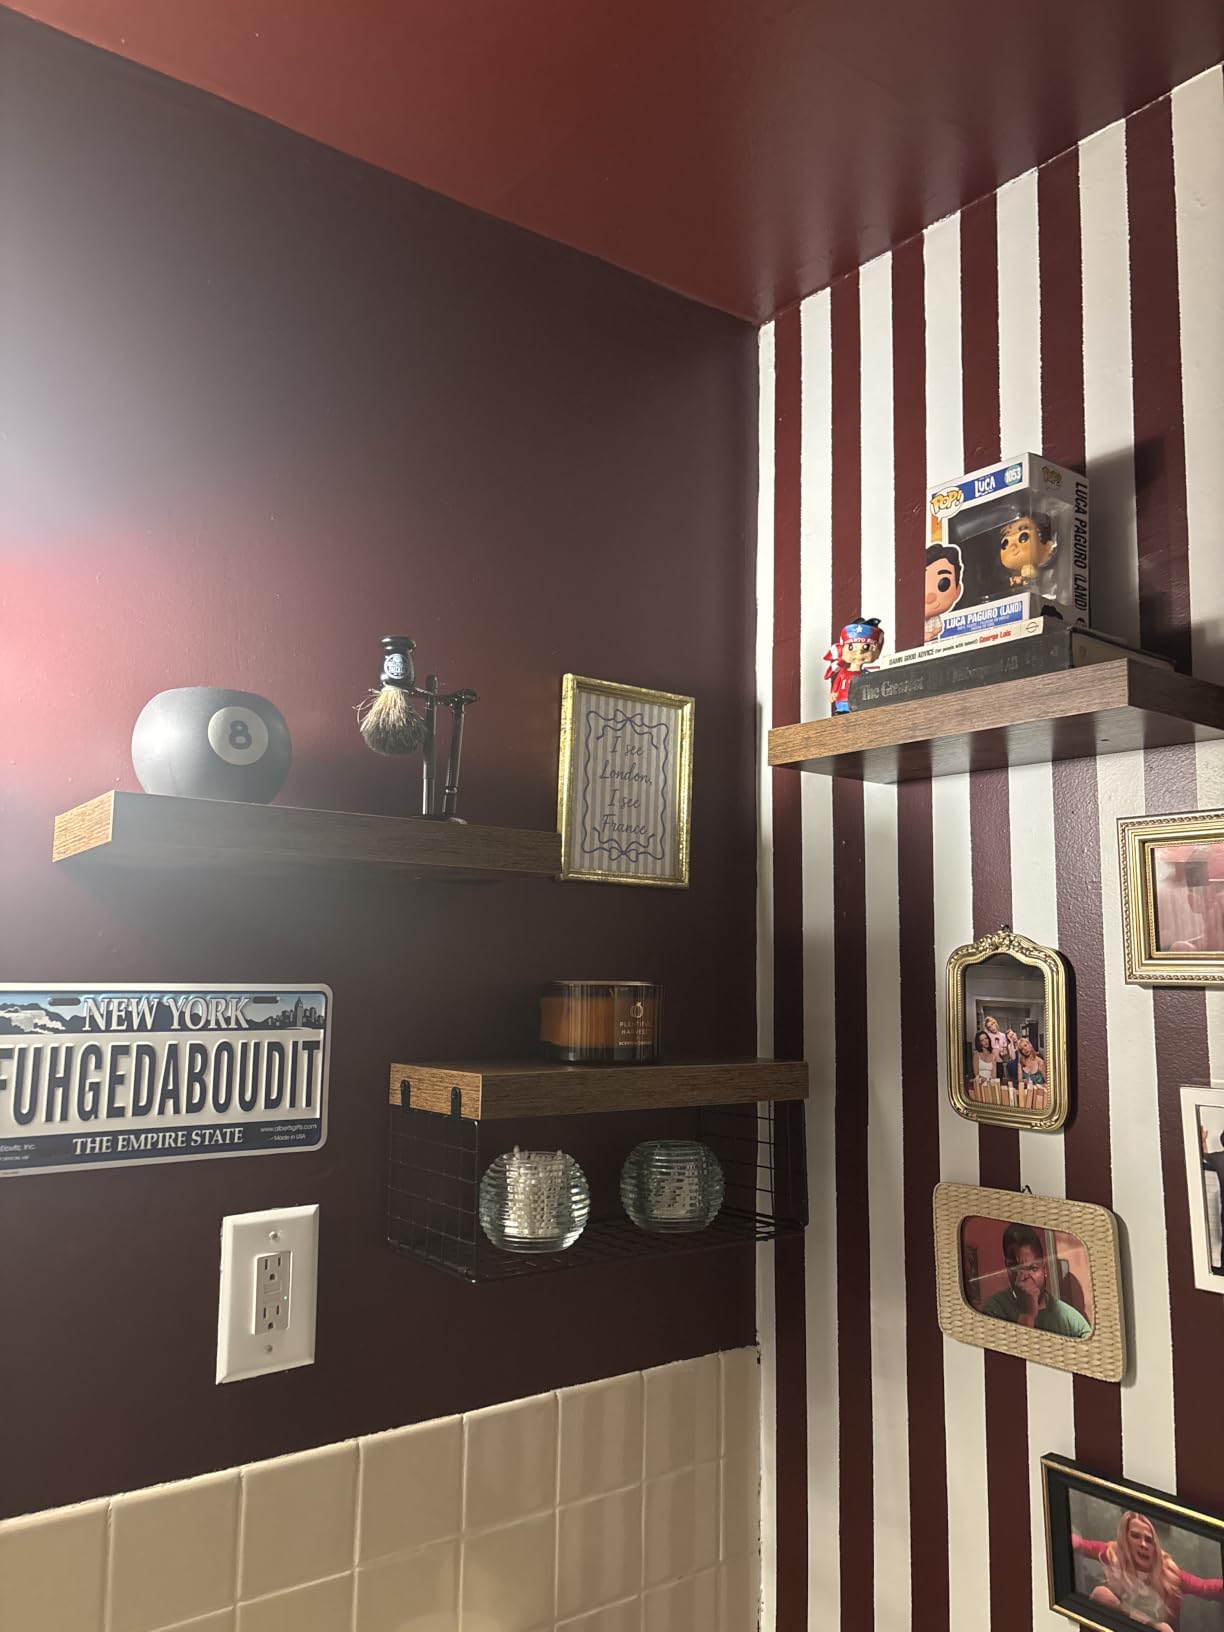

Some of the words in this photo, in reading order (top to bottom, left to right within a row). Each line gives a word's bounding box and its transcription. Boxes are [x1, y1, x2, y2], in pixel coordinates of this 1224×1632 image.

[974, 475, 997, 497] LUCA
[1005, 467, 1022, 483] 1053
[930, 489, 963, 514] POP!
[1074, 481, 1088, 513] LUCA
[1073, 515, 1088, 569] PAGURO
[1073, 573, 1088, 611] (LAND)
[946, 618, 966, 630] LUCA
[967, 608, 998, 623] PAGURO
[999, 601, 1022, 616] (LAND)
[917, 648, 935, 658] ADVICE
[979, 634, 999, 644] George
[860, 684, 880, 701] The
[229, 720, 252, 750] 8
[610, 736, 622, 753] I
[624, 744, 644, 756] see
[599, 760, 653, 785] London,
[608, 789, 620, 807] I
[621, 797, 641, 810] see
[602, 814, 648, 835] France
[82, 997, 159, 1031] NEW
[165, 997, 250, 1030] YORK
[72, 1136, 113, 1155] THE
[117, 1131, 188, 1152] EMPIRE
[191, 1128, 244, 1146] STATE
